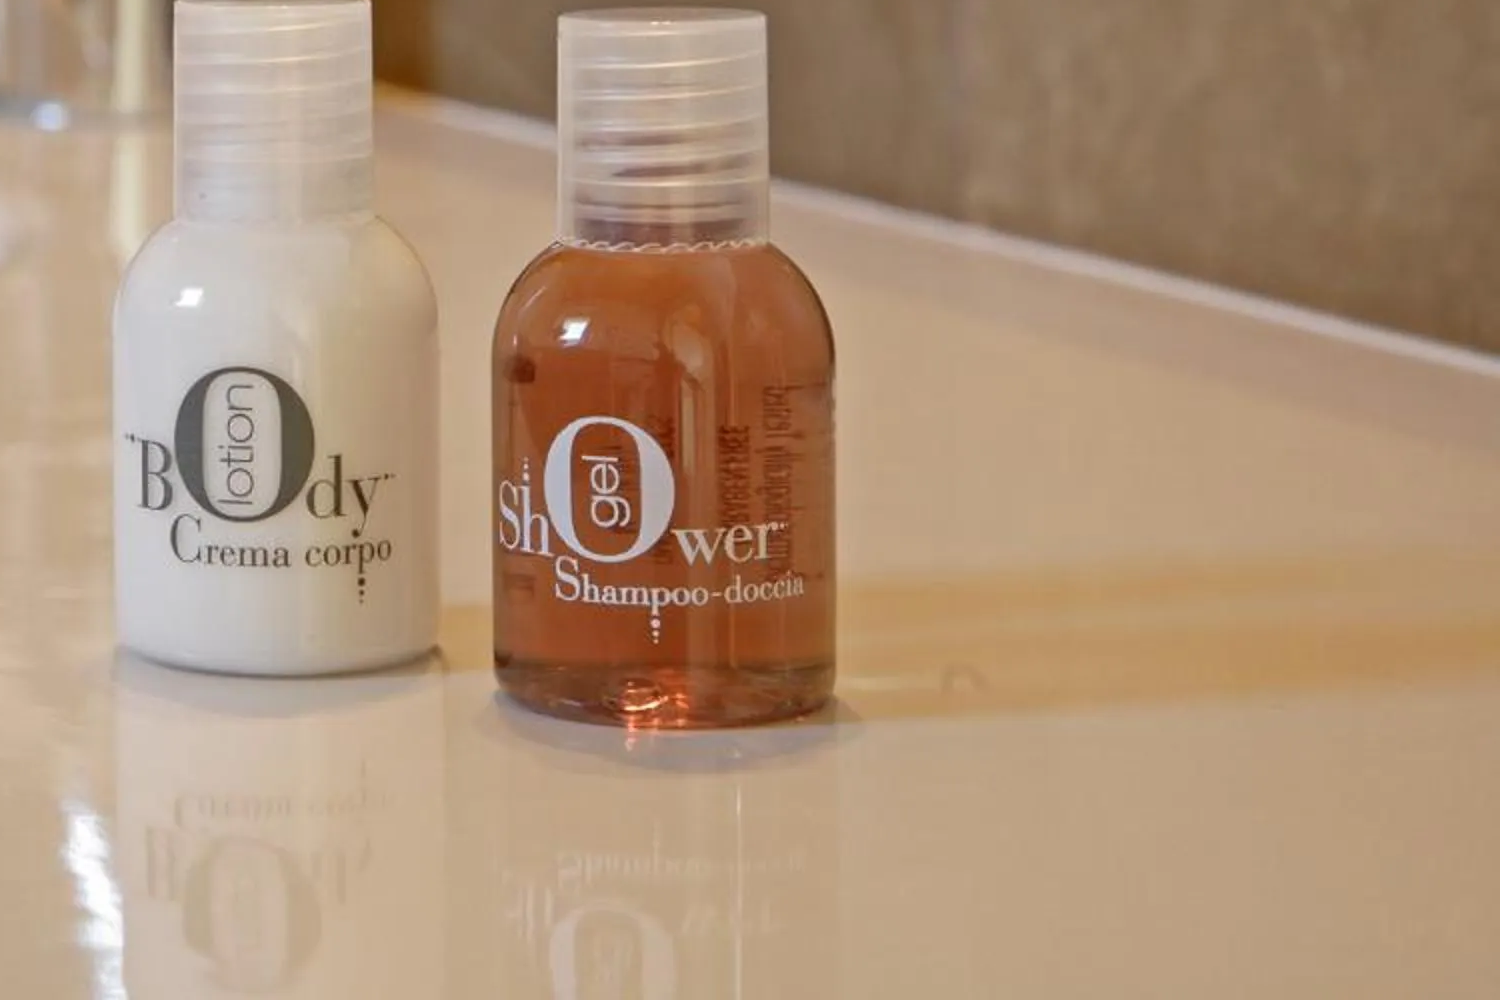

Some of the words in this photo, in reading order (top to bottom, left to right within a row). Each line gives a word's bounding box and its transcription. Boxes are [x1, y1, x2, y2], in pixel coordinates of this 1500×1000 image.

[217, 383, 255, 506] lotion
[581, 455, 632, 528] gel
[169, 513, 292, 568] Crema
[304, 539, 393, 574] corpo
[554, 555, 805, 618] Shampoo-doccia
